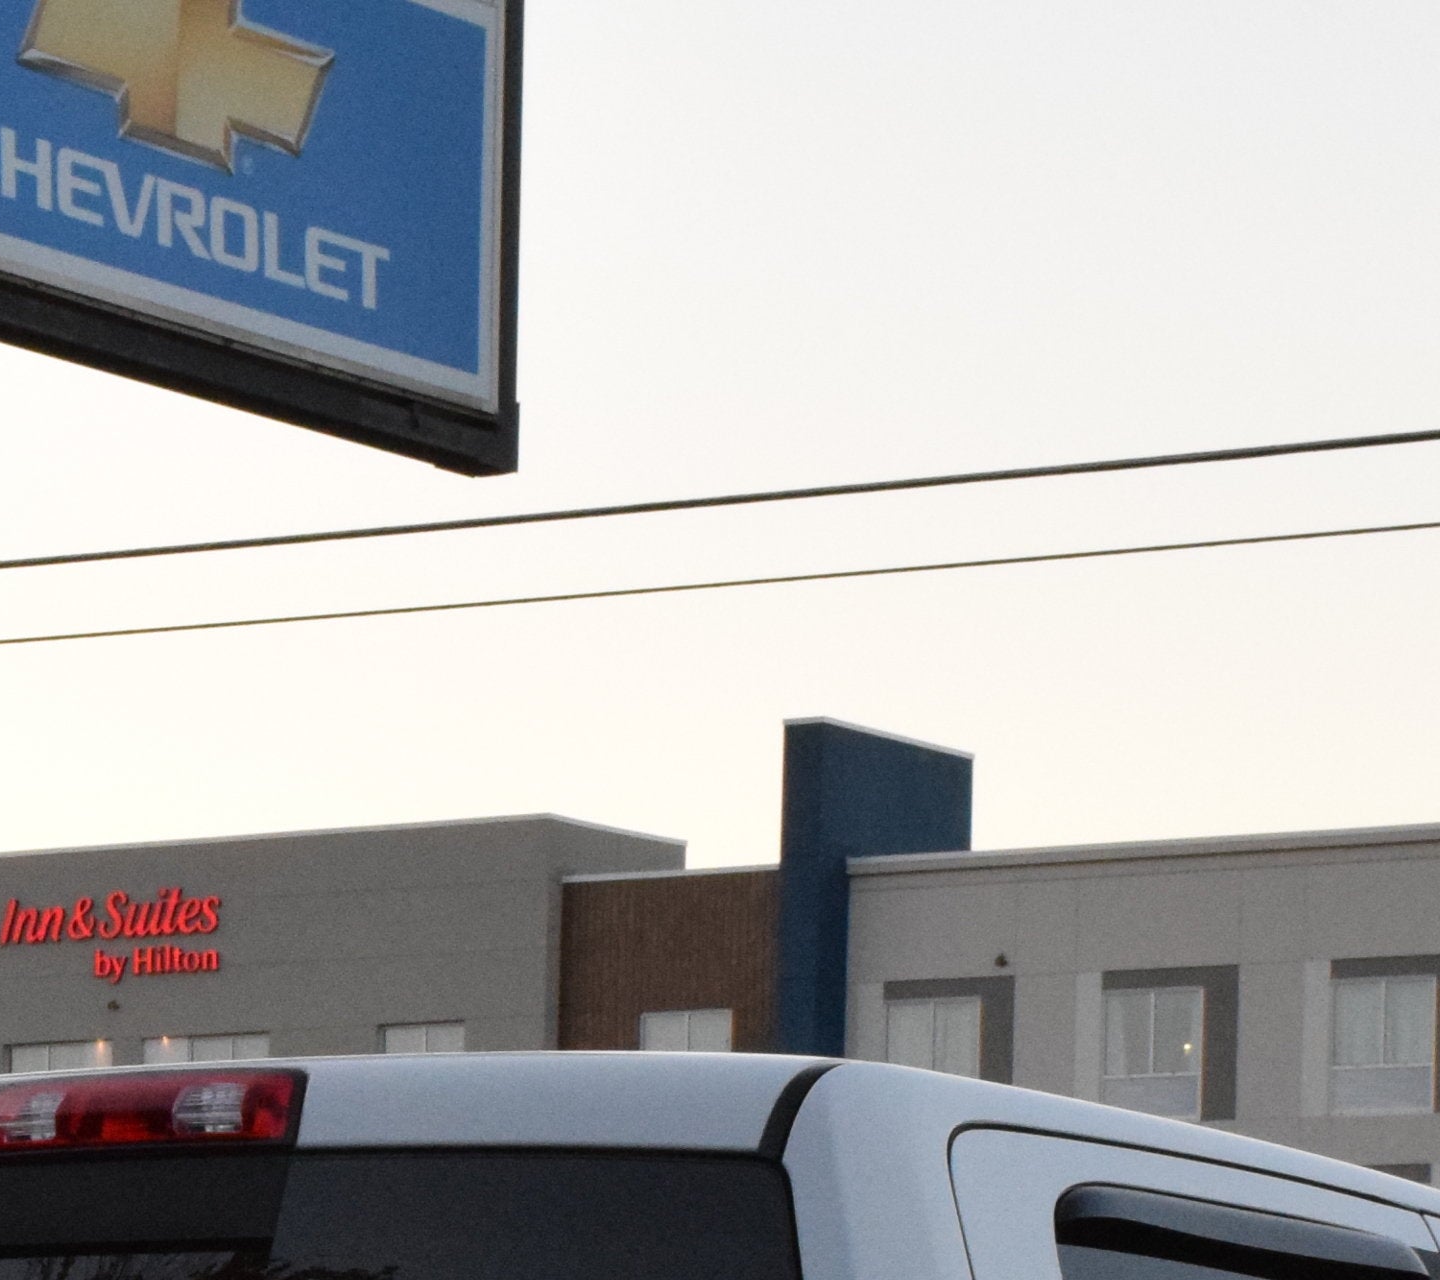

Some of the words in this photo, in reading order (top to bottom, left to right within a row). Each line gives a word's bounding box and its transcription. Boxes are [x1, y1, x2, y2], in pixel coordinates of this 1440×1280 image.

[0, 897, 65, 945] Inn
[66, 896, 97, 941] &
[97, 887, 221, 940] Suites
[93, 948, 128, 985] by
[132, 944, 219, 976] Hilton
